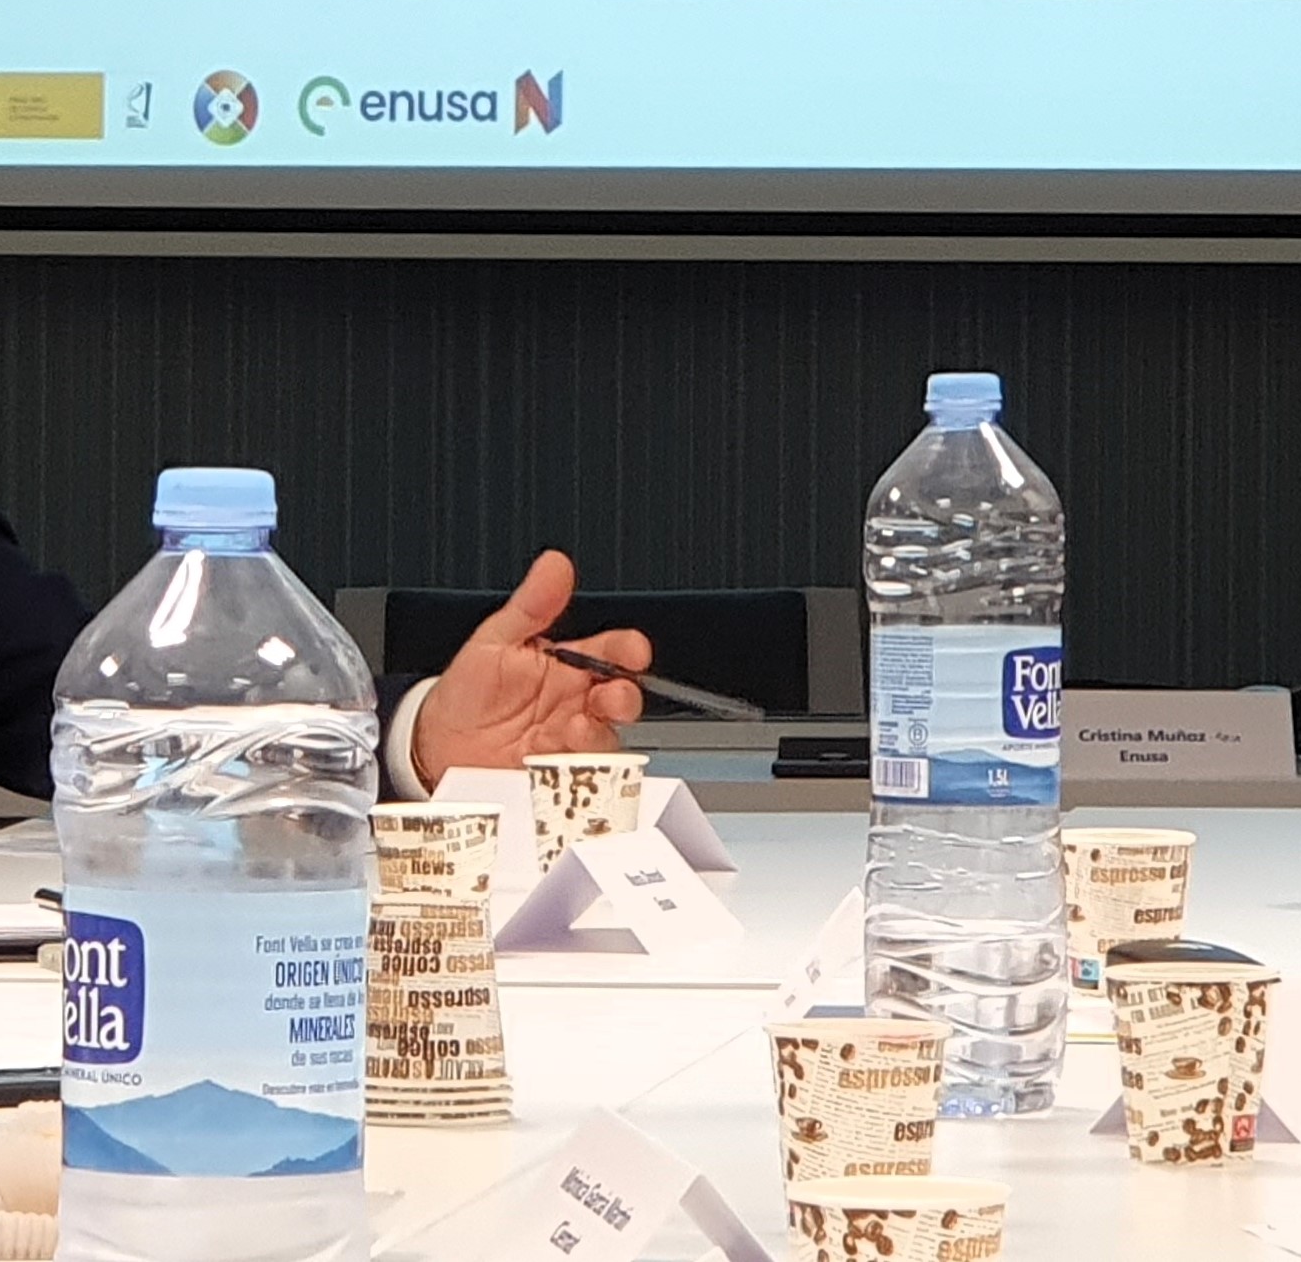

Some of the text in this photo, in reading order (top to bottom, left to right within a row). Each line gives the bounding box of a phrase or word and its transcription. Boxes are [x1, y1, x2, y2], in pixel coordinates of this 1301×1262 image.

[359, 90, 498, 123] enusa
[1078, 728, 1143, 743] Cristina
[1148, 726, 1207, 743] Muñoz
[1120, 750, 1169, 763] Enusa
[256, 935, 286, 954] Font
[64, 937, 128, 988] ont
[275, 960, 330, 988] ORIGEN
[64, 985, 131, 1051] ella
[289, 1013, 355, 1044] MINERALES
